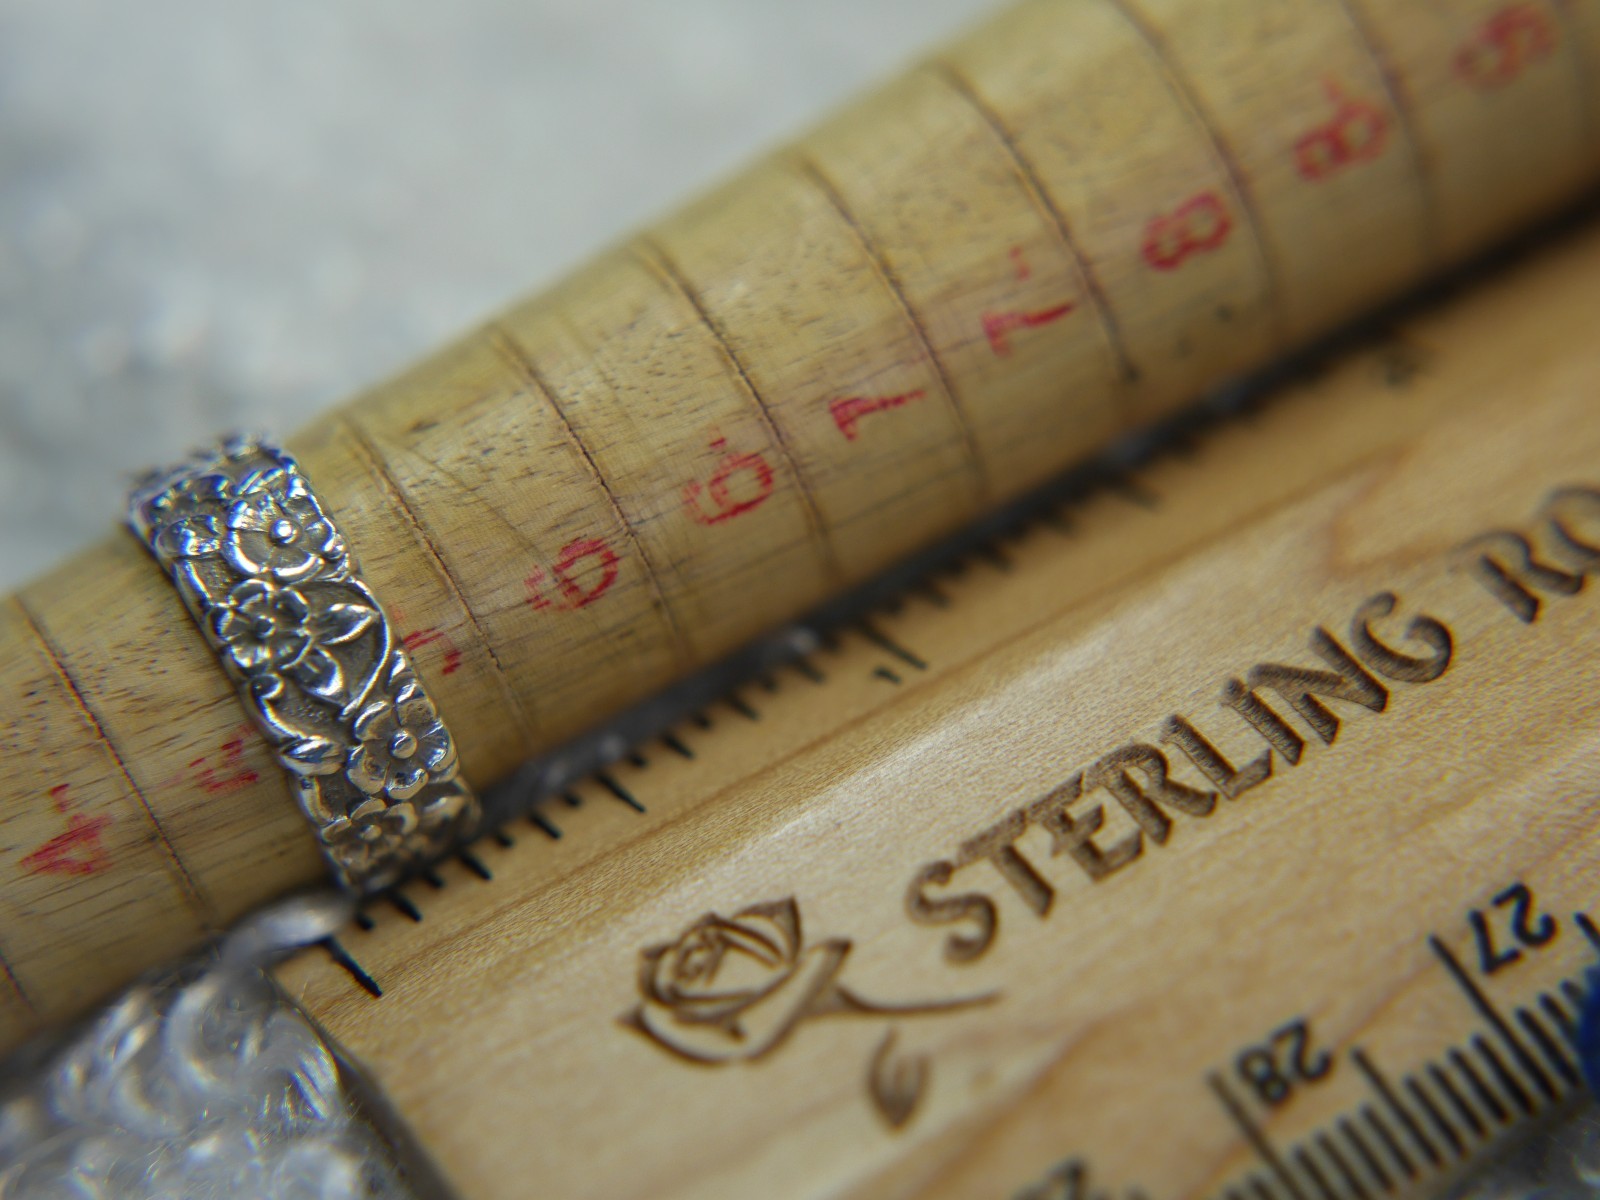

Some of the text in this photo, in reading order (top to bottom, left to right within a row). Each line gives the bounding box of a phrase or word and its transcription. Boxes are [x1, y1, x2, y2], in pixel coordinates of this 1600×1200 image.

[1141, 191, 1232, 272] 8
[904, 590, 1452, 965] STERLING
[1467, 881, 1557, 976] 27
[1233, 1016, 1335, 1105] 28
